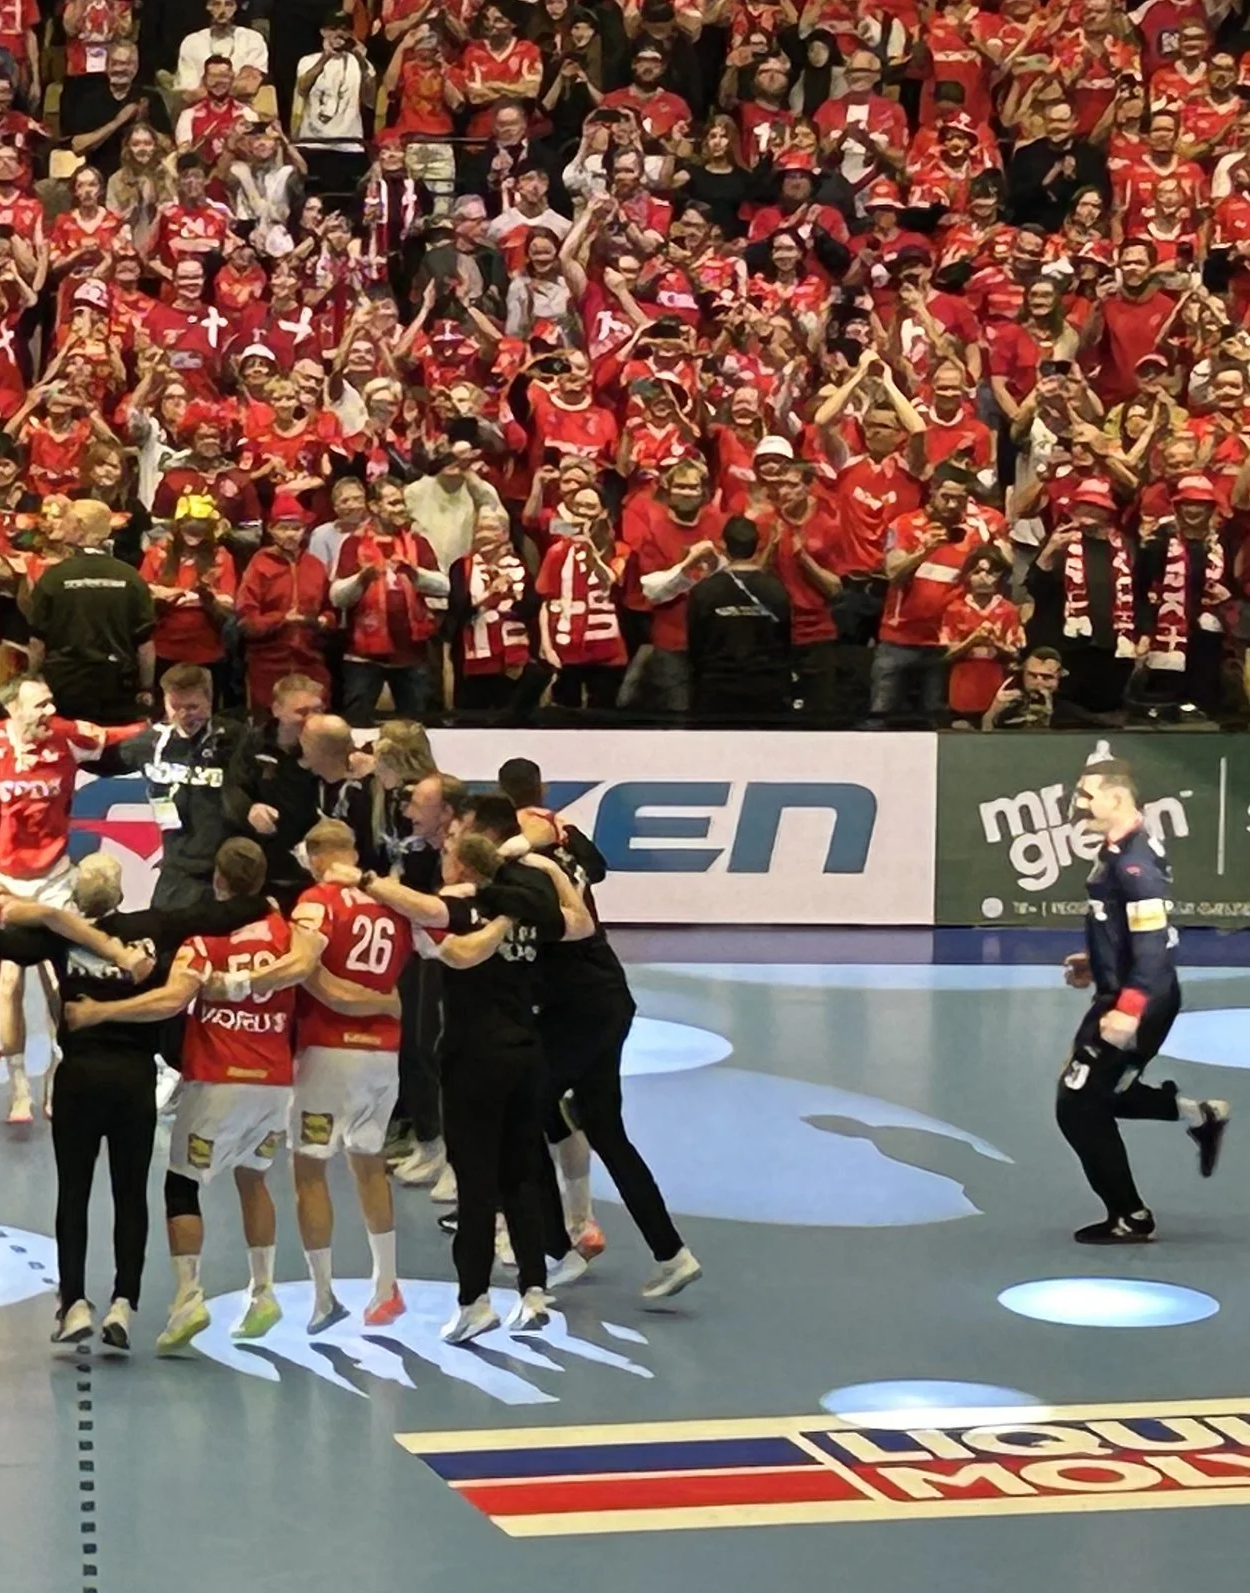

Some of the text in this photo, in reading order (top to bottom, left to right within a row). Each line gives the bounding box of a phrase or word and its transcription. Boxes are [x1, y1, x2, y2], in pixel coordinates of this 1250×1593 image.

[979, 783, 1063, 843] mr
[1010, 796, 1189, 891] gren
[346, 914, 394, 974] 26
